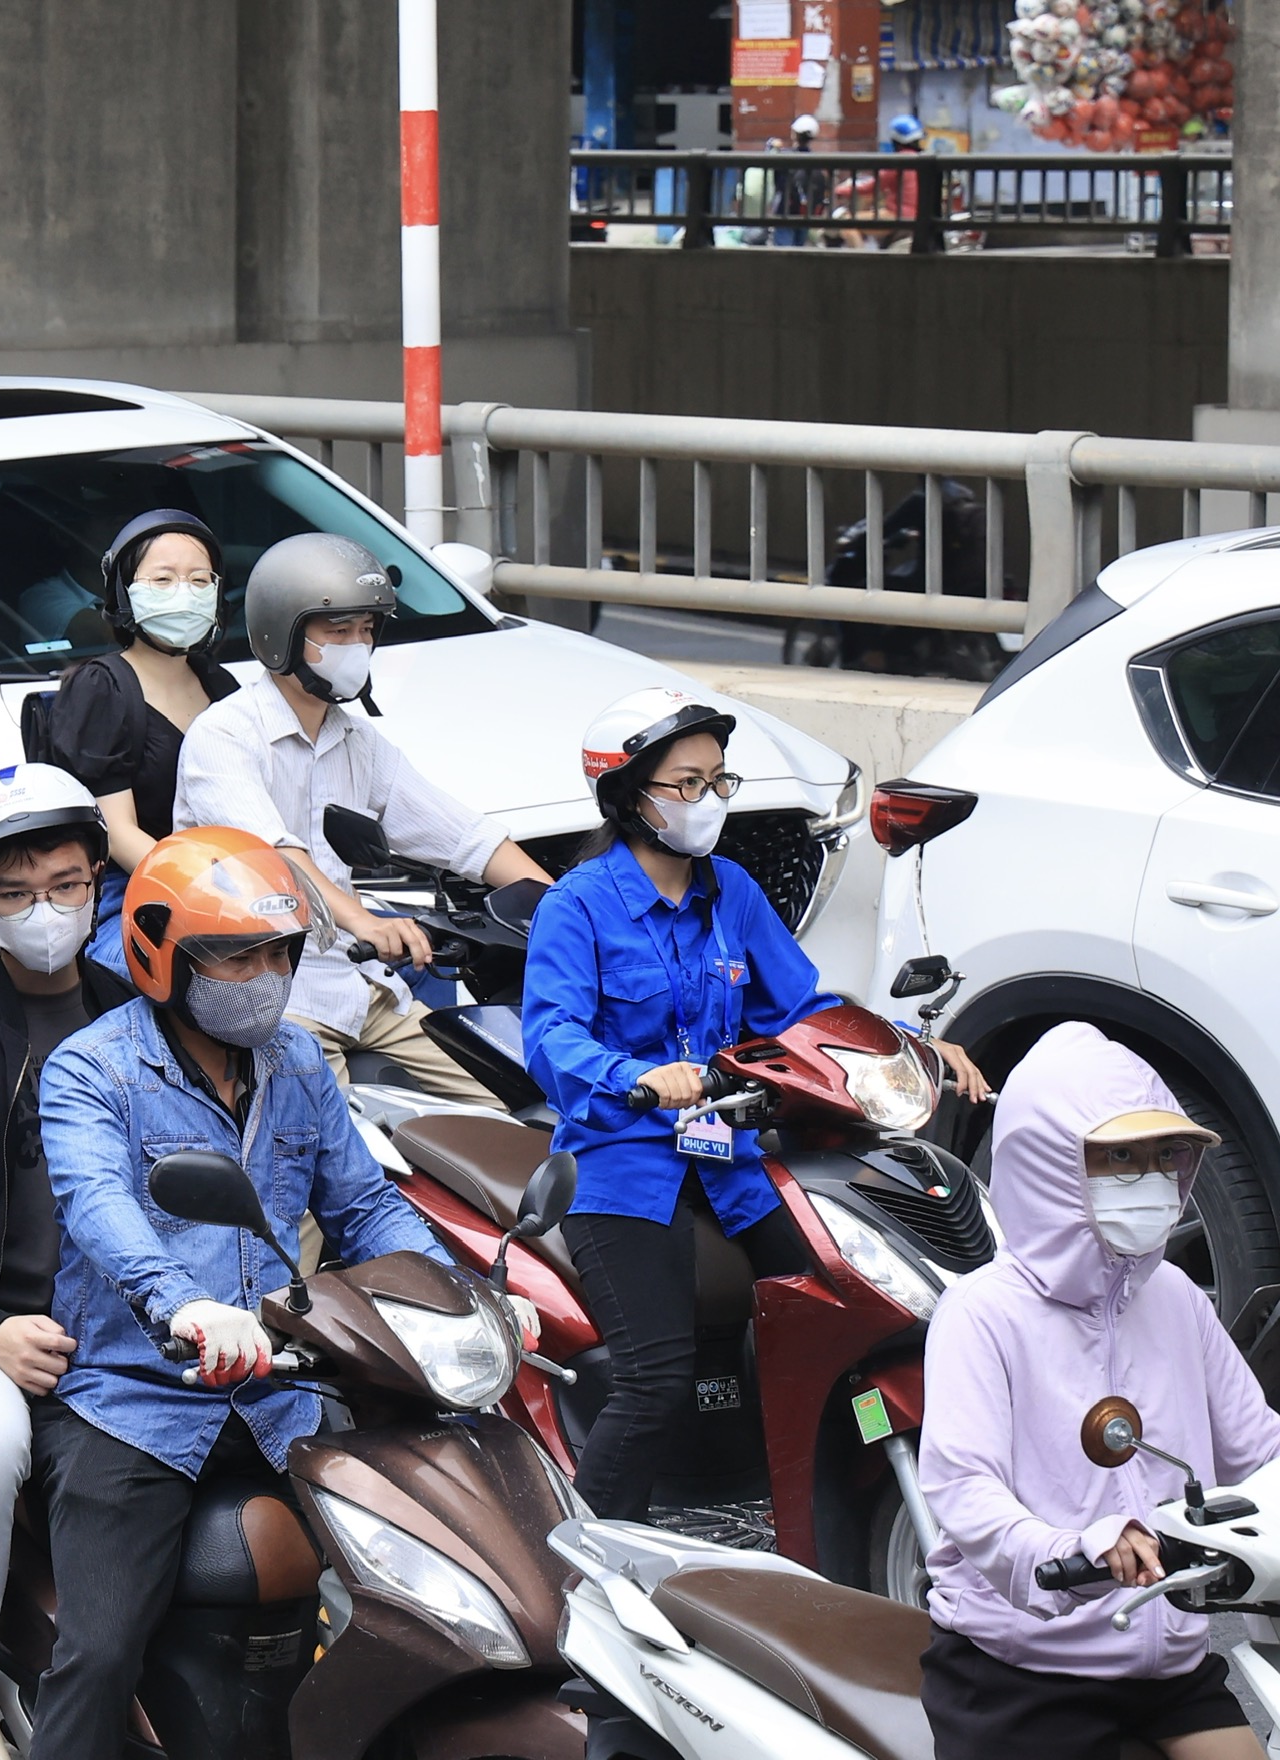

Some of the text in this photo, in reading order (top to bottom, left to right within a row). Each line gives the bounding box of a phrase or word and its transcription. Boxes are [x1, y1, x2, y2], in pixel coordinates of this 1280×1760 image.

[258, 898, 295, 912] HJC
[683, 1137, 726, 1157] PHỤC VỤ
[639, 1662, 725, 1732] VISION
